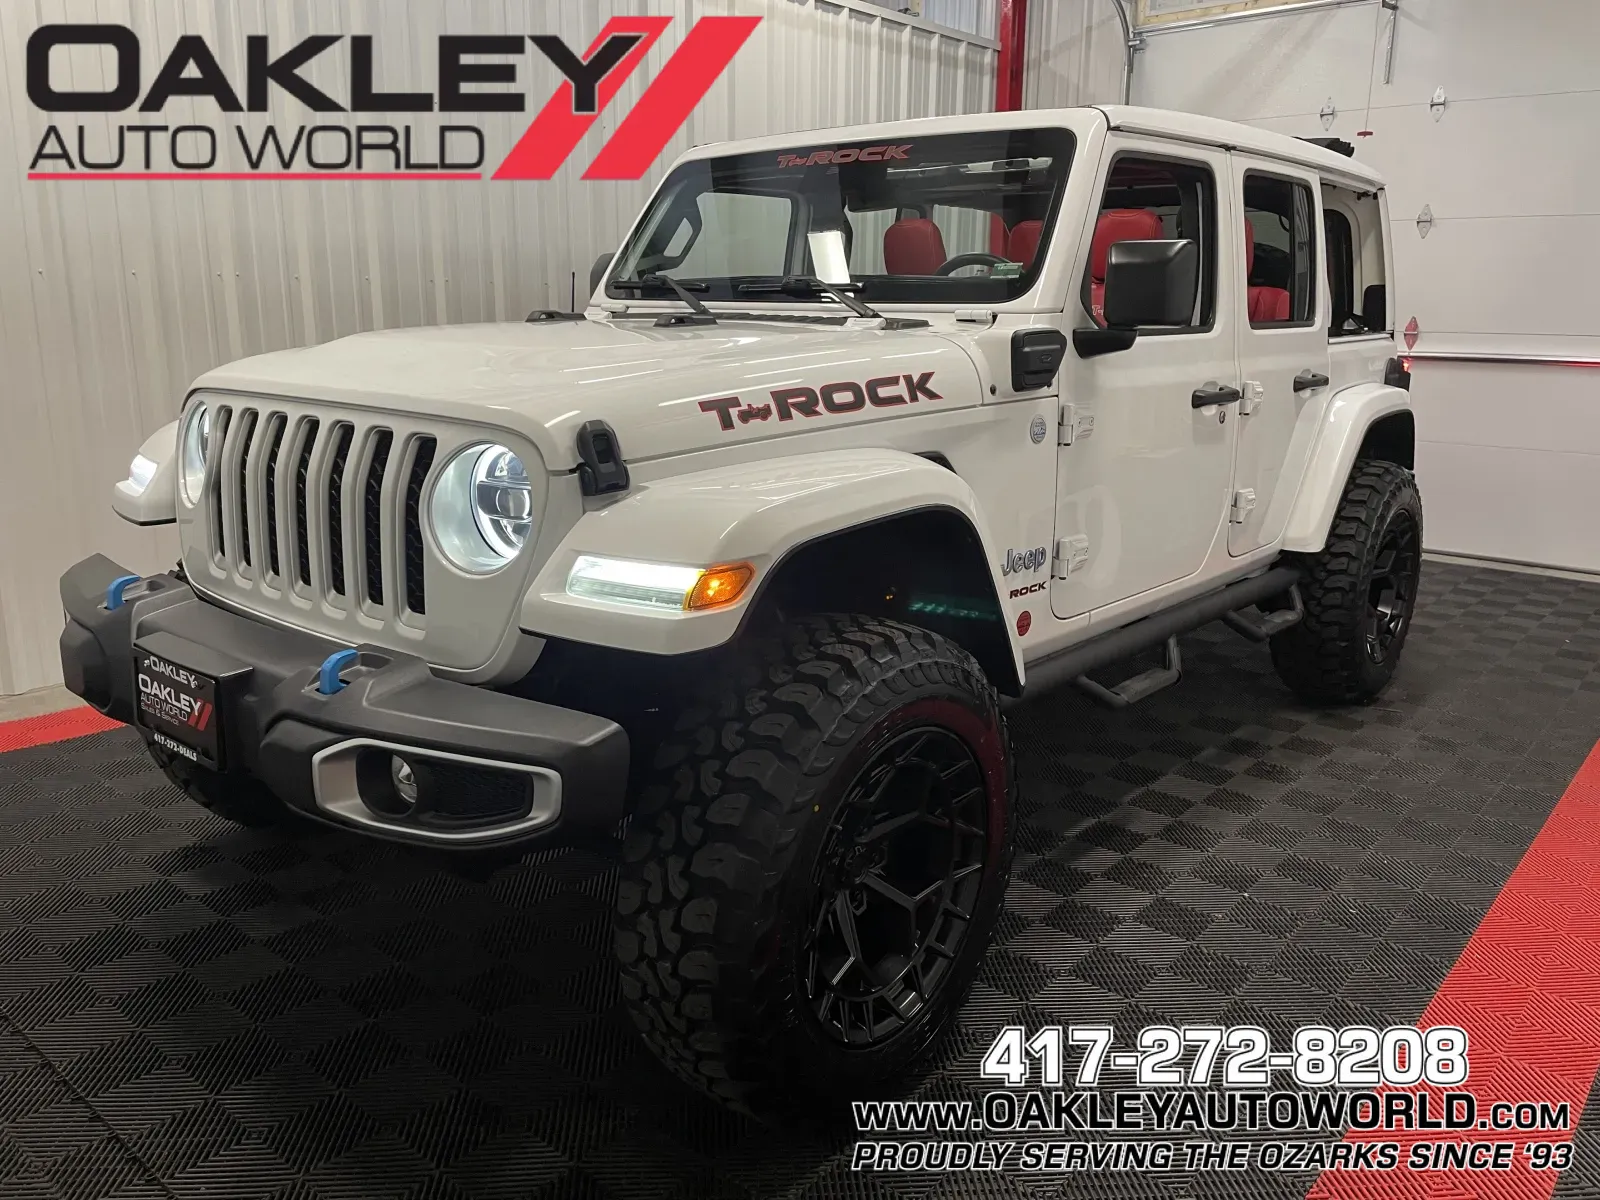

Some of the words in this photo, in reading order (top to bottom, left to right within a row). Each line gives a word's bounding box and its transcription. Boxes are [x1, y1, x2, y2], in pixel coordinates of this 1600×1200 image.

[1001, 546, 1047, 577] Jeep
[1009, 580, 1048, 600] ROCK
[149, 655, 196, 687] OAKLEY
[138, 673, 202, 716] OAKLEY
[140, 692, 161, 709] AUTO
[160, 700, 188, 722] WORLD
[153, 732, 198, 762] 417-272-DEALS
